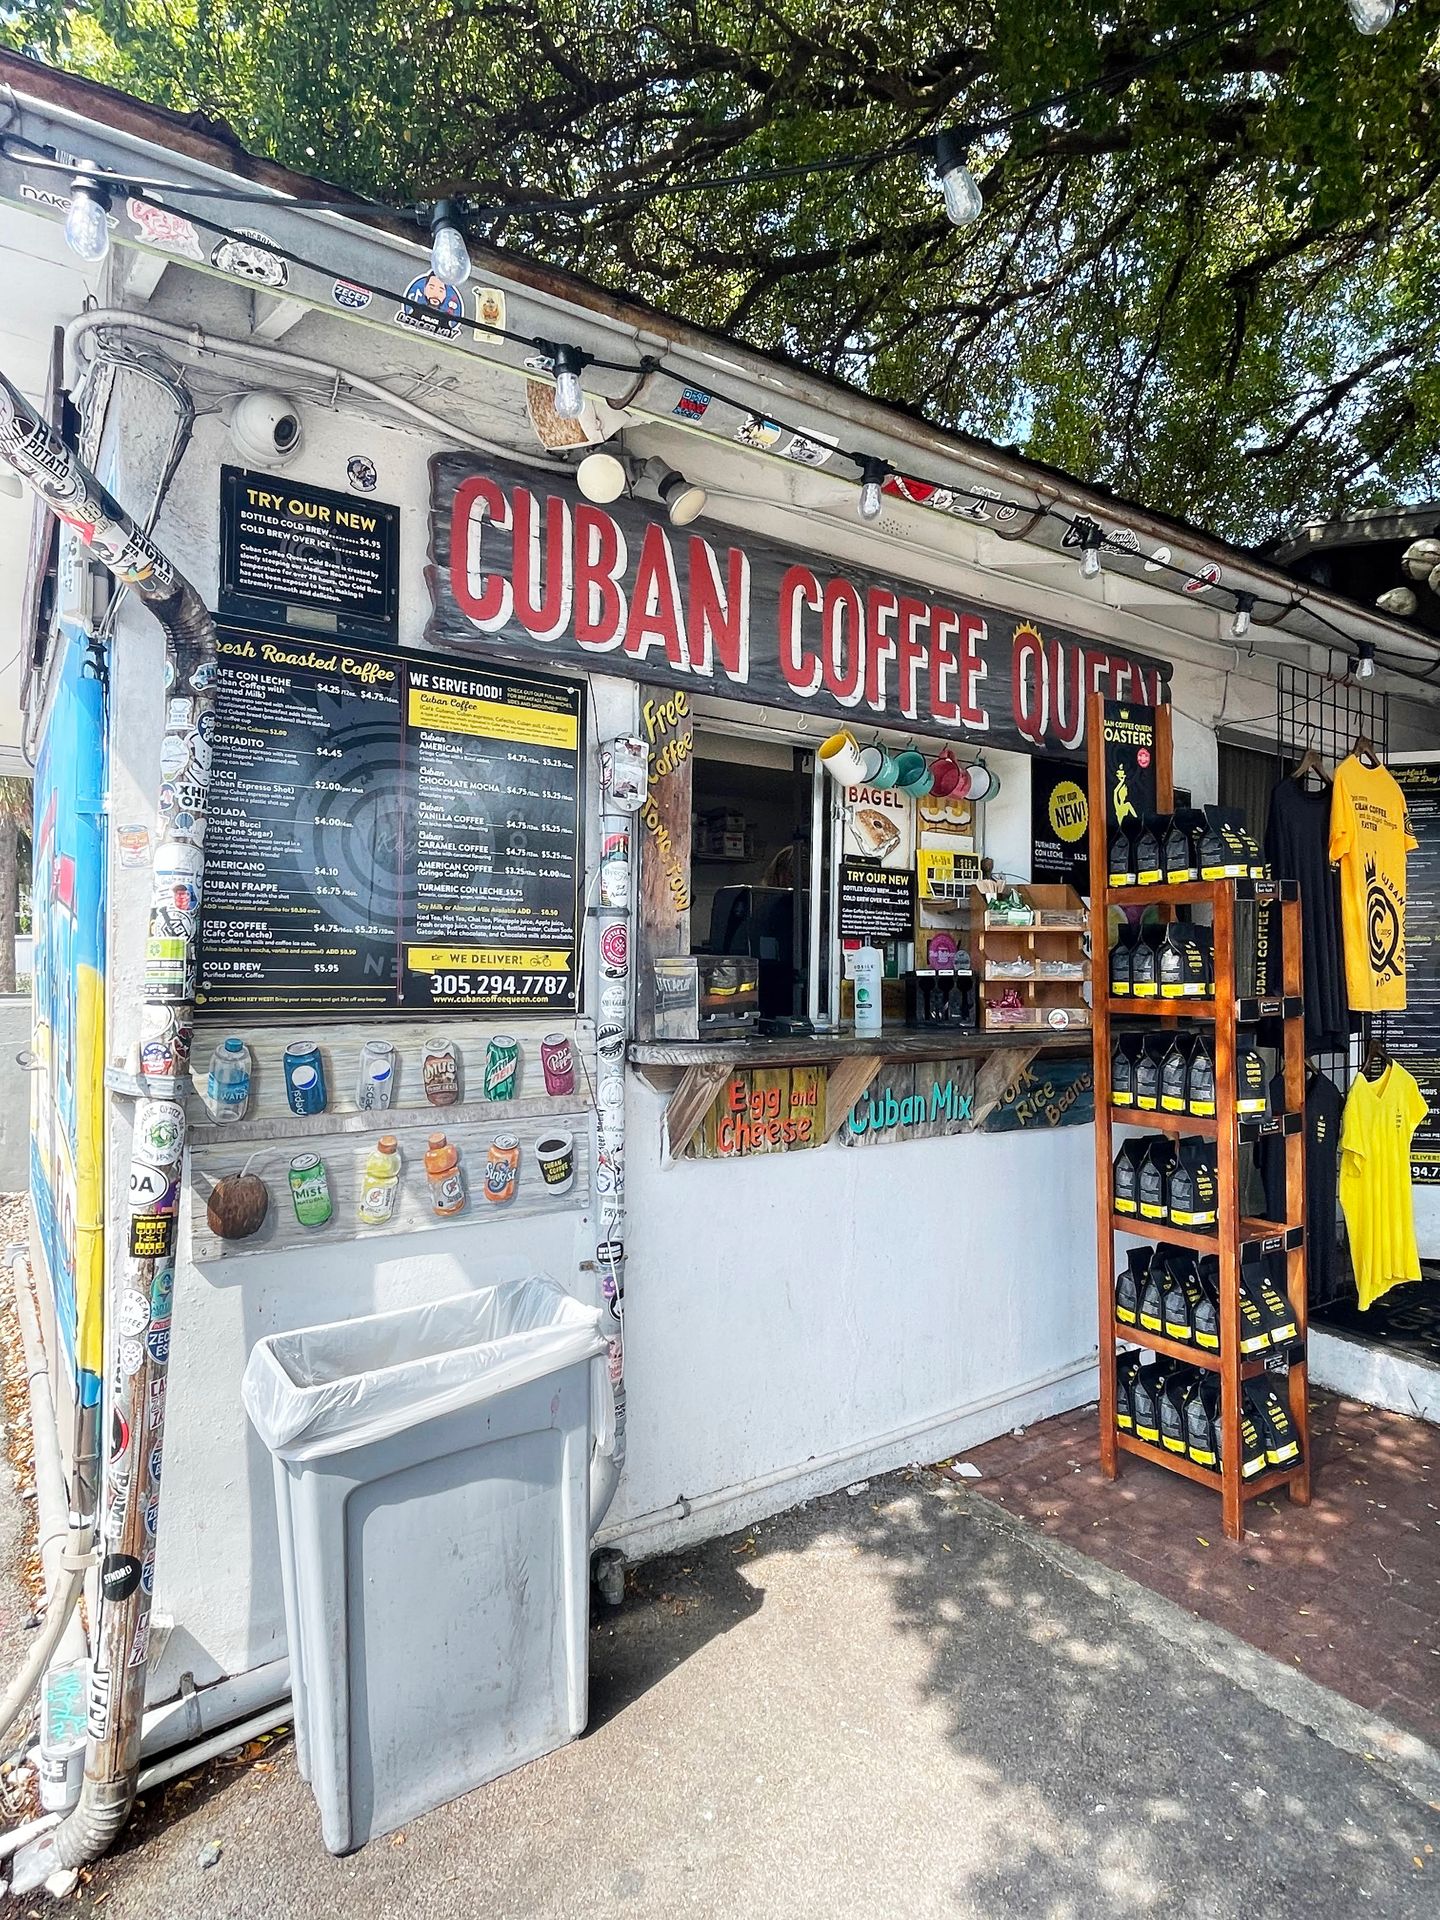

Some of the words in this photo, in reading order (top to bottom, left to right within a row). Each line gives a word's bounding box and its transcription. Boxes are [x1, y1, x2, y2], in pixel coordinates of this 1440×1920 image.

[336, 286, 368, 302] ZECER
[339, 296, 359, 308] ESA
[399, 313, 435, 333] OFFICER
[436, 326, 456, 339] KAY
[25, 439, 70, 478] POTATO
[246, 488, 284, 510] TRY
[288, 499, 331, 522] OUR
[335, 509, 377, 533] NEW
[240, 510, 279, 525] BOTTLED
[280, 519, 305, 531] COLD
[305, 525, 329, 536] BREW
[359, 537, 381, 549] $4.95
[240, 523, 265, 535] COLD
[266, 528, 291, 541] BREW
[292, 534, 316, 546] OVER
[317, 540, 331, 549] ICE
[359, 549, 381, 561] $5.95
[240, 543, 262, 554] Cuban
[262, 548, 285, 559] Coffee
[286, 553, 308, 563] Queen
[308, 557, 323, 566] Cold
[324, 560, 340, 570] Brew
[370, 571, 379, 580] by
[240, 552, 261, 563] slowly
[262, 557, 291, 569] steeping
[303, 564, 329, 576] Medium
[329, 570, 348, 580] Roast
[450, 476, 751, 684] CUBAN
[778, 565, 989, 730] COFFEE
[216, 640, 257, 658] resh
[260, 643, 338, 671] Roasted
[341, 657, 396, 684] Coffee
[216, 668, 234, 678] AFE
[235, 671, 259, 682] CON
[260, 675, 292, 687] LECHE
[238, 680, 266, 691] Coffee
[267, 685, 285, 694] with
[409, 671, 429, 688] WE
[431, 676, 469, 694] SERVE
[469, 683, 503, 700] FOOD!
[420, 693, 448, 706] Cuban
[450, 698, 478, 712] Coffee
[643, 689, 690, 744] Free
[1104, 719, 1115, 727] BAN
[1114, 721, 1135, 730] COFFEE
[1134, 723, 1153, 732] QUEEN
[213, 734, 265, 748] ORTADITO
[316, 747, 343, 758] $4.45
[419, 731, 446, 743] Cuban
[1104, 727, 1153, 747] OASTERS
[419, 741, 463, 754] AMERICAN
[507, 753, 528, 763] $4.75
[542, 758, 562, 768] $5.25
[212, 769, 237, 780] UCCI
[237, 781, 272, 792] Espresso
[273, 785, 295, 795] Shot)
[418, 775, 469, 789] CHOCOLATE
[469, 781, 500, 793] MOCHA
[506, 786, 527, 796] $4.75
[542, 790, 561, 800] $5.25
[848, 786, 904, 809] BAGEL
[207, 806, 247, 818] COLADA
[1055, 800, 1087, 829] NEW!
[239, 820, 261, 829] Bucci
[418, 811, 453, 822] VANILLA
[453, 815, 485, 825] COFFEE
[506, 820, 527, 830] $4.75
[541, 823, 561, 833] $5.25
[224, 827, 246, 836] Cane
[247, 829, 274, 838] Sugar)
[417, 840, 457, 851] CARAMEL
[458, 844, 489, 854] COFFEE
[505, 847, 526, 857] $4.75
[541, 850, 561, 860] $5.25
[1034, 849, 1046, 857] CON
[205, 860, 265, 872] AMERICANO
[314, 866, 339, 876] $4.10
[417, 860, 461, 871] AMERICAN
[462, 863, 493, 873] COFFEE
[417, 868, 444, 879] (Gringo
[444, 870, 470, 880] Coffee)
[846, 870, 865, 883] TRY
[866, 873, 887, 885] OUR
[888, 875, 909, 886] NEW
[203, 880, 239, 890] CUBAN
[241, 882, 279, 892] FRAPPE
[316, 886, 341, 896] $6.75
[417, 883, 460, 893] TURMERIC
[459, 885, 478, 895] CON
[479, 886, 503, 896] LECHE
[842, 884, 863, 893] BOTTLED
[864, 886, 877, 894] COLD
[1381, 872, 1406, 906] CUBAN
[842, 894, 856, 902] COLD
[856, 895, 870, 903] BREW
[870, 896, 882, 904] OVER
[202, 920, 228, 929] ICED
[228, 921, 268, 931] COFFEE
[354, 925, 378, 934] $5.25
[202, 930, 226, 938] (Cafe
[227, 930, 244, 938] Con
[246, 931, 273, 940] Leche)
[1257, 910, 1268, 958] COFFEE
[202, 962, 231, 971] COLD
[233, 962, 262, 971] BREW
[313, 963, 340, 973] $5.95
[449, 953, 468, 964] WE
[471, 953, 523, 965] DELIVER!
[430, 974, 568, 996] 305.294.7787
[433, 995, 549, 1005] www.cubancoffeequeen.com
[557, 1048, 568, 1060] Dr
[220, 1093, 248, 1101] WATER
[292, 1089, 307, 1117] pepsi
[729, 1079, 782, 1121] Egg
[791, 1083, 818, 1108] and
[1016, 1080, 1056, 1127] Rice
[1044, 1072, 1092, 1127] Beans
[847, 1088, 926, 1137] Cuban
[929, 1079, 975, 1123] Mix
[717, 1113, 814, 1154] Cheese
[549, 1162, 569, 1175] COFFEE
[293, 1186, 322, 1200] Mist
